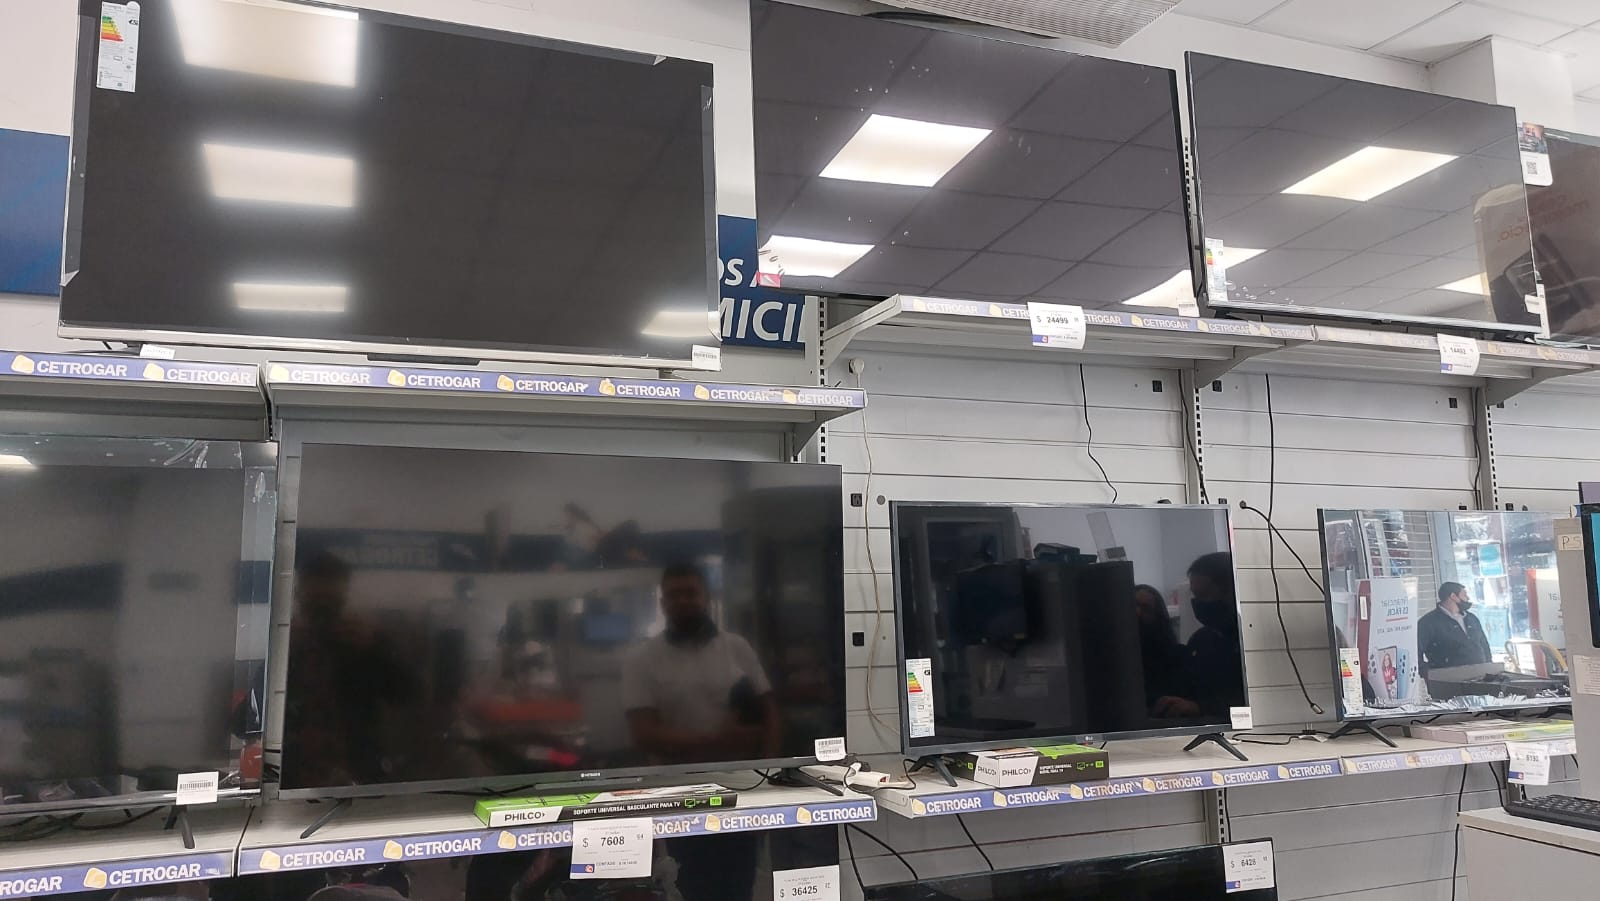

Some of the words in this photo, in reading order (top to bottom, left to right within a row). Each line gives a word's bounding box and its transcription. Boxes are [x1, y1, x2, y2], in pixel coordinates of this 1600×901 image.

[926, 303, 977, 314] CETROGAR
[1046, 316, 1069, 325] 24499
[1143, 319, 1188, 329] CETROGAR
[37, 361, 128, 377] CETROGAR
[167, 368, 251, 384] CETROGAR
[291, 369, 370, 384] CETROGAR
[408, 374, 481, 389] CETROGAR
[516, 379, 584, 393] CETROGAR
[617, 384, 680, 398] CETROGAR
[711, 389, 770, 401] CETROGAR
[798, 393, 853, 406] CETROGAR
[977, 765, 995, 775] PHILCO
[1290, 764, 1332, 778] CETROGAR
[1357, 758, 1398, 771] CETROGAR
[1002, 767, 1029, 777] PHILCO
[1224, 770, 1269, 784] CETROGAR
[1084, 782, 1134, 797] CETROGAR
[1155, 776, 1204, 791] CETROGAR
[1008, 790, 1060, 805] CETROGAR
[573, 808, 598, 816] SOPORTE
[598, 806, 627, 814] UNIVERSAL
[927, 797, 982, 814] CETROGAR
[504, 812, 542, 822] PHILCO
[723, 813, 784, 829] CETROGAR
[813, 807, 872, 822] CETROGAR
[405, 838, 481, 857] CETROGAR
[582, 837, 589, 848] $
[600, 835, 625, 847] 7608
[283, 848, 365, 867] CETROGAR
[110, 864, 200, 886] CETROGAR
[779, 888, 785, 898] $
[791, 885, 818, 897] 36425
